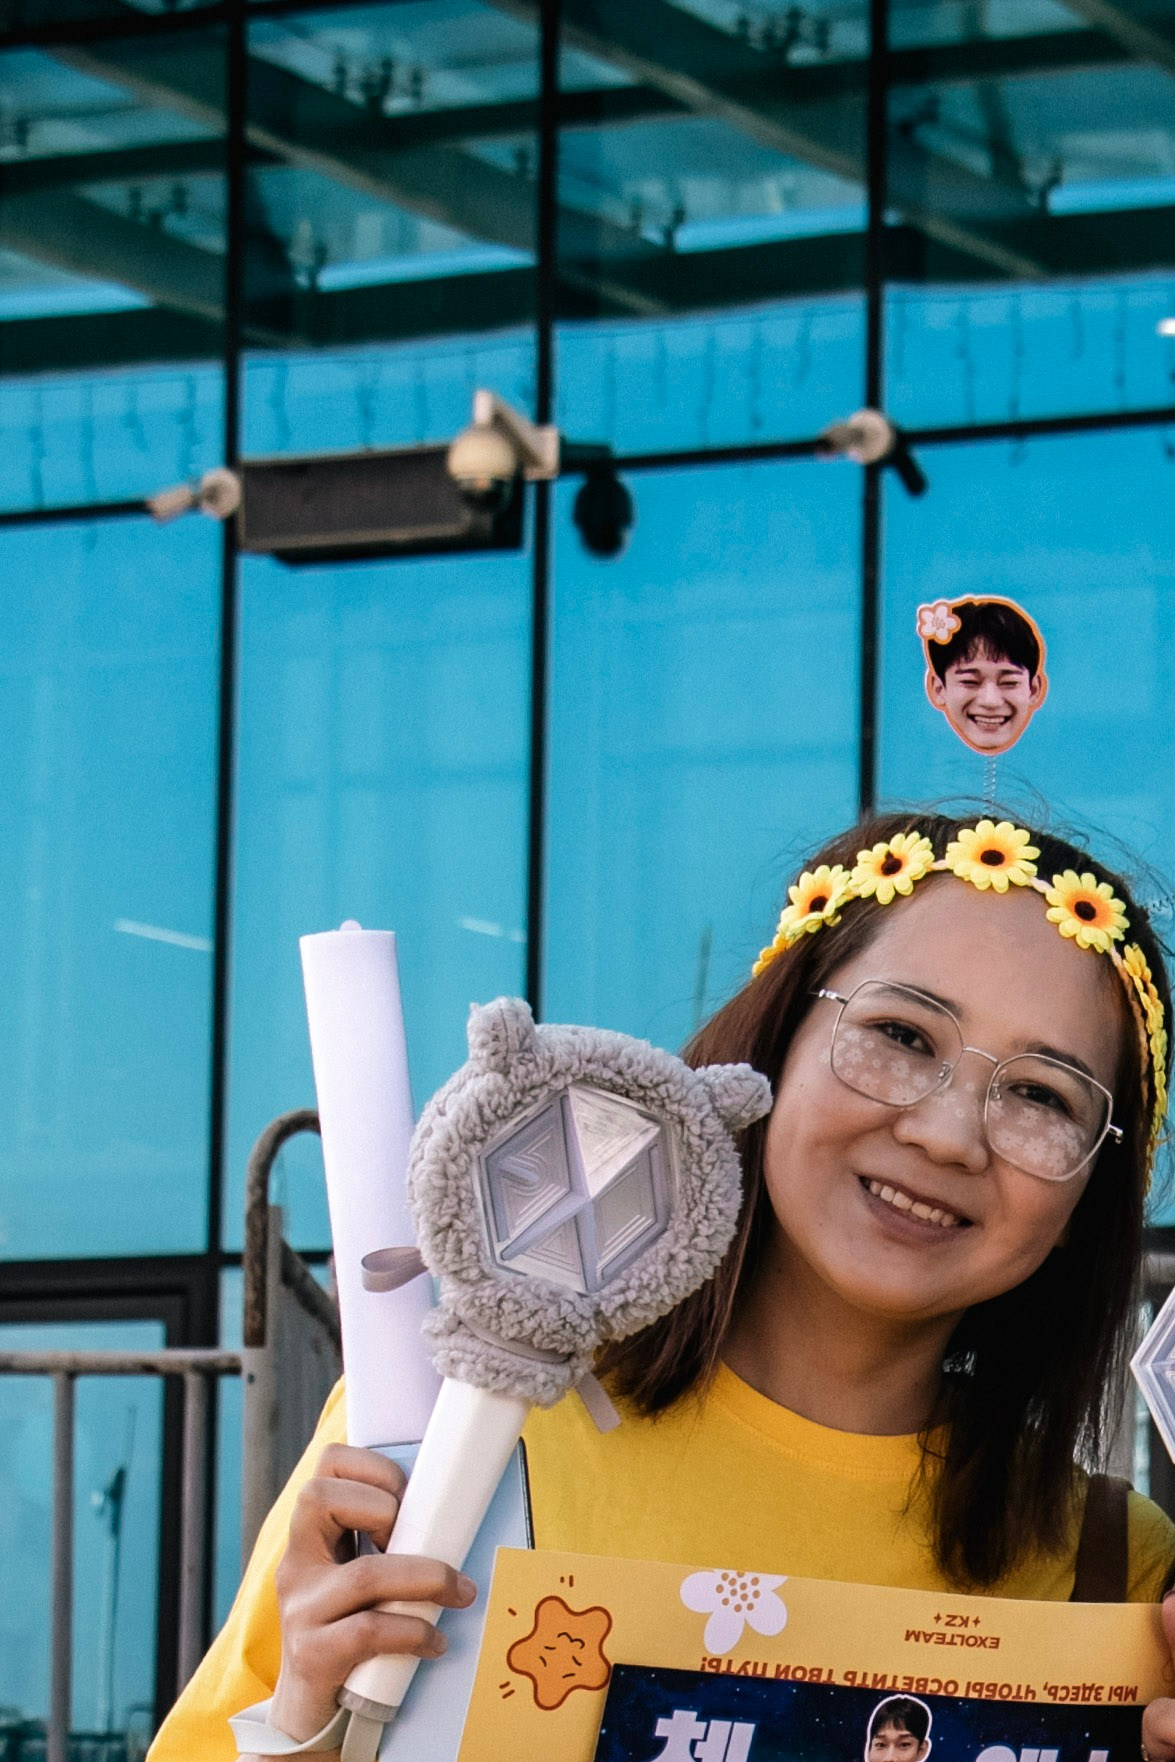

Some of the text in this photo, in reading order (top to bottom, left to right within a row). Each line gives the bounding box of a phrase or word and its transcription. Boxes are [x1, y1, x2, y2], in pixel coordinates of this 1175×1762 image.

[944, 1613, 970, 1629] KZ
[904, 1629, 1001, 1650] EXOLTEAM
[842, 1668, 959, 1697] ОСВЕТИТЬ
[965, 1678, 1037, 1701] ЧТОБЫ
[1042, 1680, 1104, 1702] ЗДЕСЬ,
[1108, 1684, 1138, 1702] МЫ
